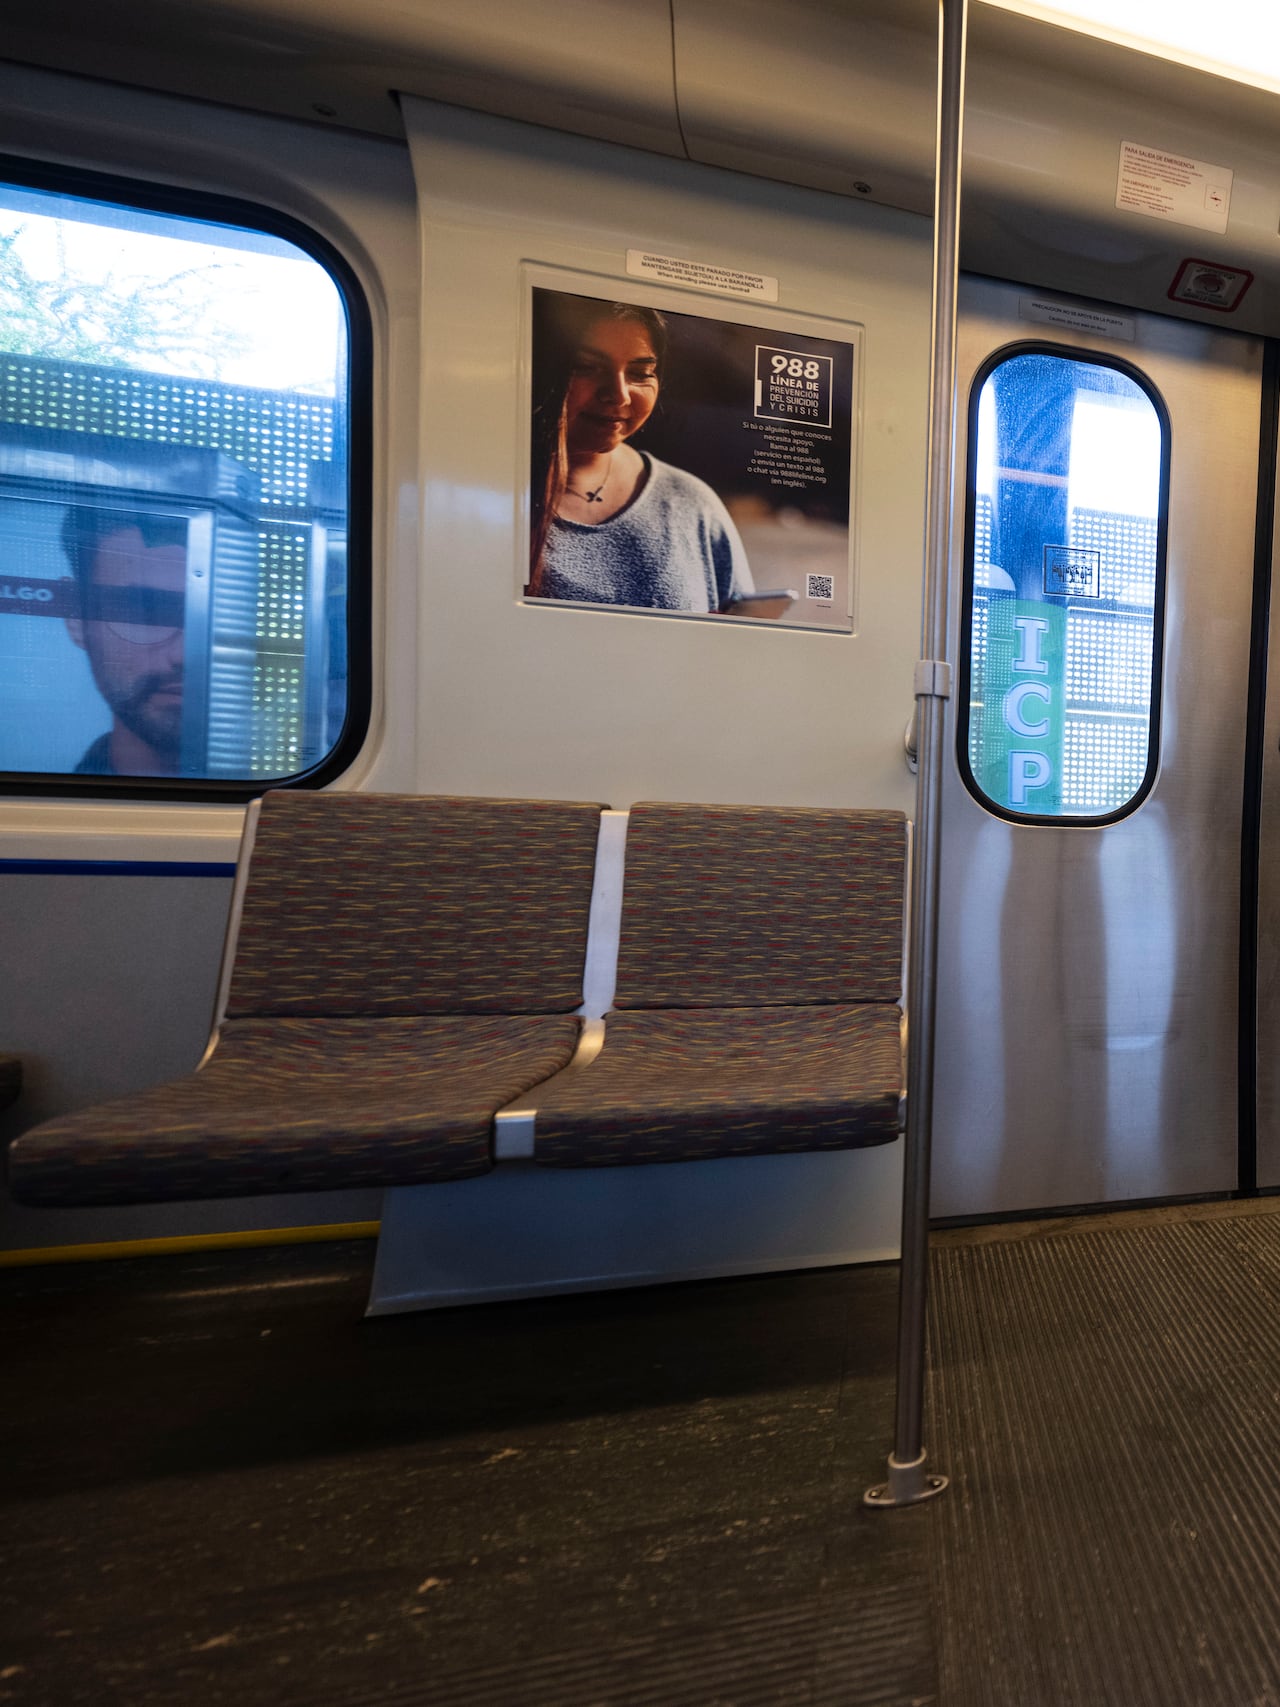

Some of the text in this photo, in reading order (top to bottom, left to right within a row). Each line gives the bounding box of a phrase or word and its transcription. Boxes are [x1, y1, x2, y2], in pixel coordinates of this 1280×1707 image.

[641, 261, 682, 274] MANTENGASE
[729, 278, 764, 290] BARANDILLA
[643, 255, 763, 283] CUANDO USTED ESTE PARADO POR FAVOR
[771, 355, 819, 379] 988
[770, 374, 819, 391] LÍNEA DE
[770, 384, 819, 399] PREVENCIÓN
[770, 393, 819, 408] DEL SUICIDIO
[770, 402, 819, 417] Y CRISIS
[764, 434, 815, 447] necesita apoyo,
[765, 425, 790, 434] alguien
[790, 429, 803, 437] que
[804, 431, 832, 441] conoces
[770, 442, 788, 451] llama
[754, 449, 782, 459] (servicio
[793, 455, 821, 465] español)
[753, 466, 768, 475] chat
[786, 462, 804, 471] texto
[812, 466, 824, 474] 988
[771, 477, 782, 485] (en
[0, 584, 54, 601] LGO
